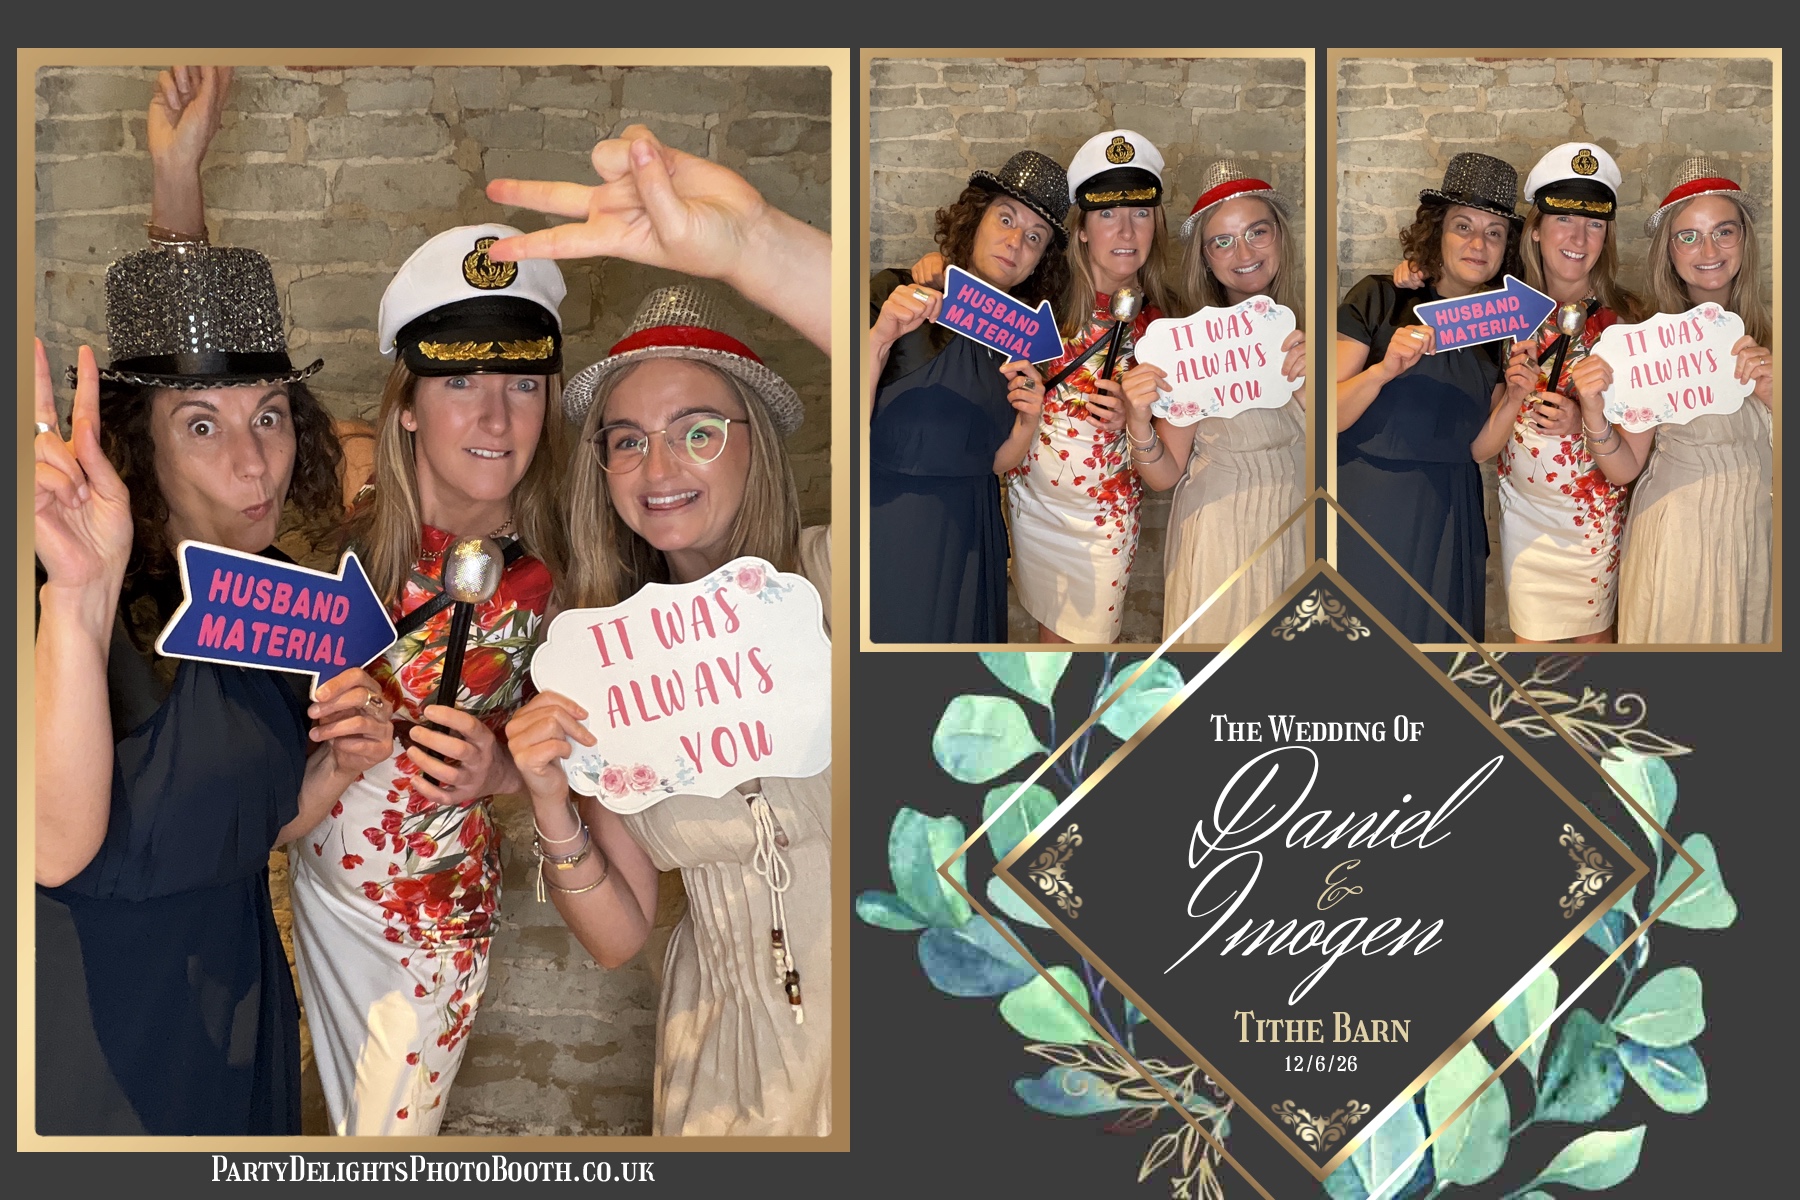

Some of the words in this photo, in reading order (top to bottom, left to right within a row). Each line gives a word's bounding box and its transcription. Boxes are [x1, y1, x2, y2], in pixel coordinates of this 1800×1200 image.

[957, 284, 1039, 336] HUSBAND
[1435, 296, 1520, 326] HUSBAND
[1440, 315, 1529, 344] MATERIAL
[946, 305, 1031, 358] MATERIAL
[1168, 322, 1194, 352] IT
[1205, 311, 1253, 343] WAS
[1622, 328, 1648, 357] IT
[1657, 318, 1704, 348] WAS
[1175, 343, 1267, 383] ALWAYS
[1629, 348, 1718, 389] ALWAYS
[1213, 380, 1262, 407] YOU
[1666, 386, 1715, 413] YOU
[209, 569, 350, 625] HUSBAND
[198, 614, 346, 666] MATERIAL
[589, 618, 633, 668] IT
[651, 588, 739, 649] WAS
[608, 648, 773, 728] ALWAYS
[680, 721, 772, 773] YOU
